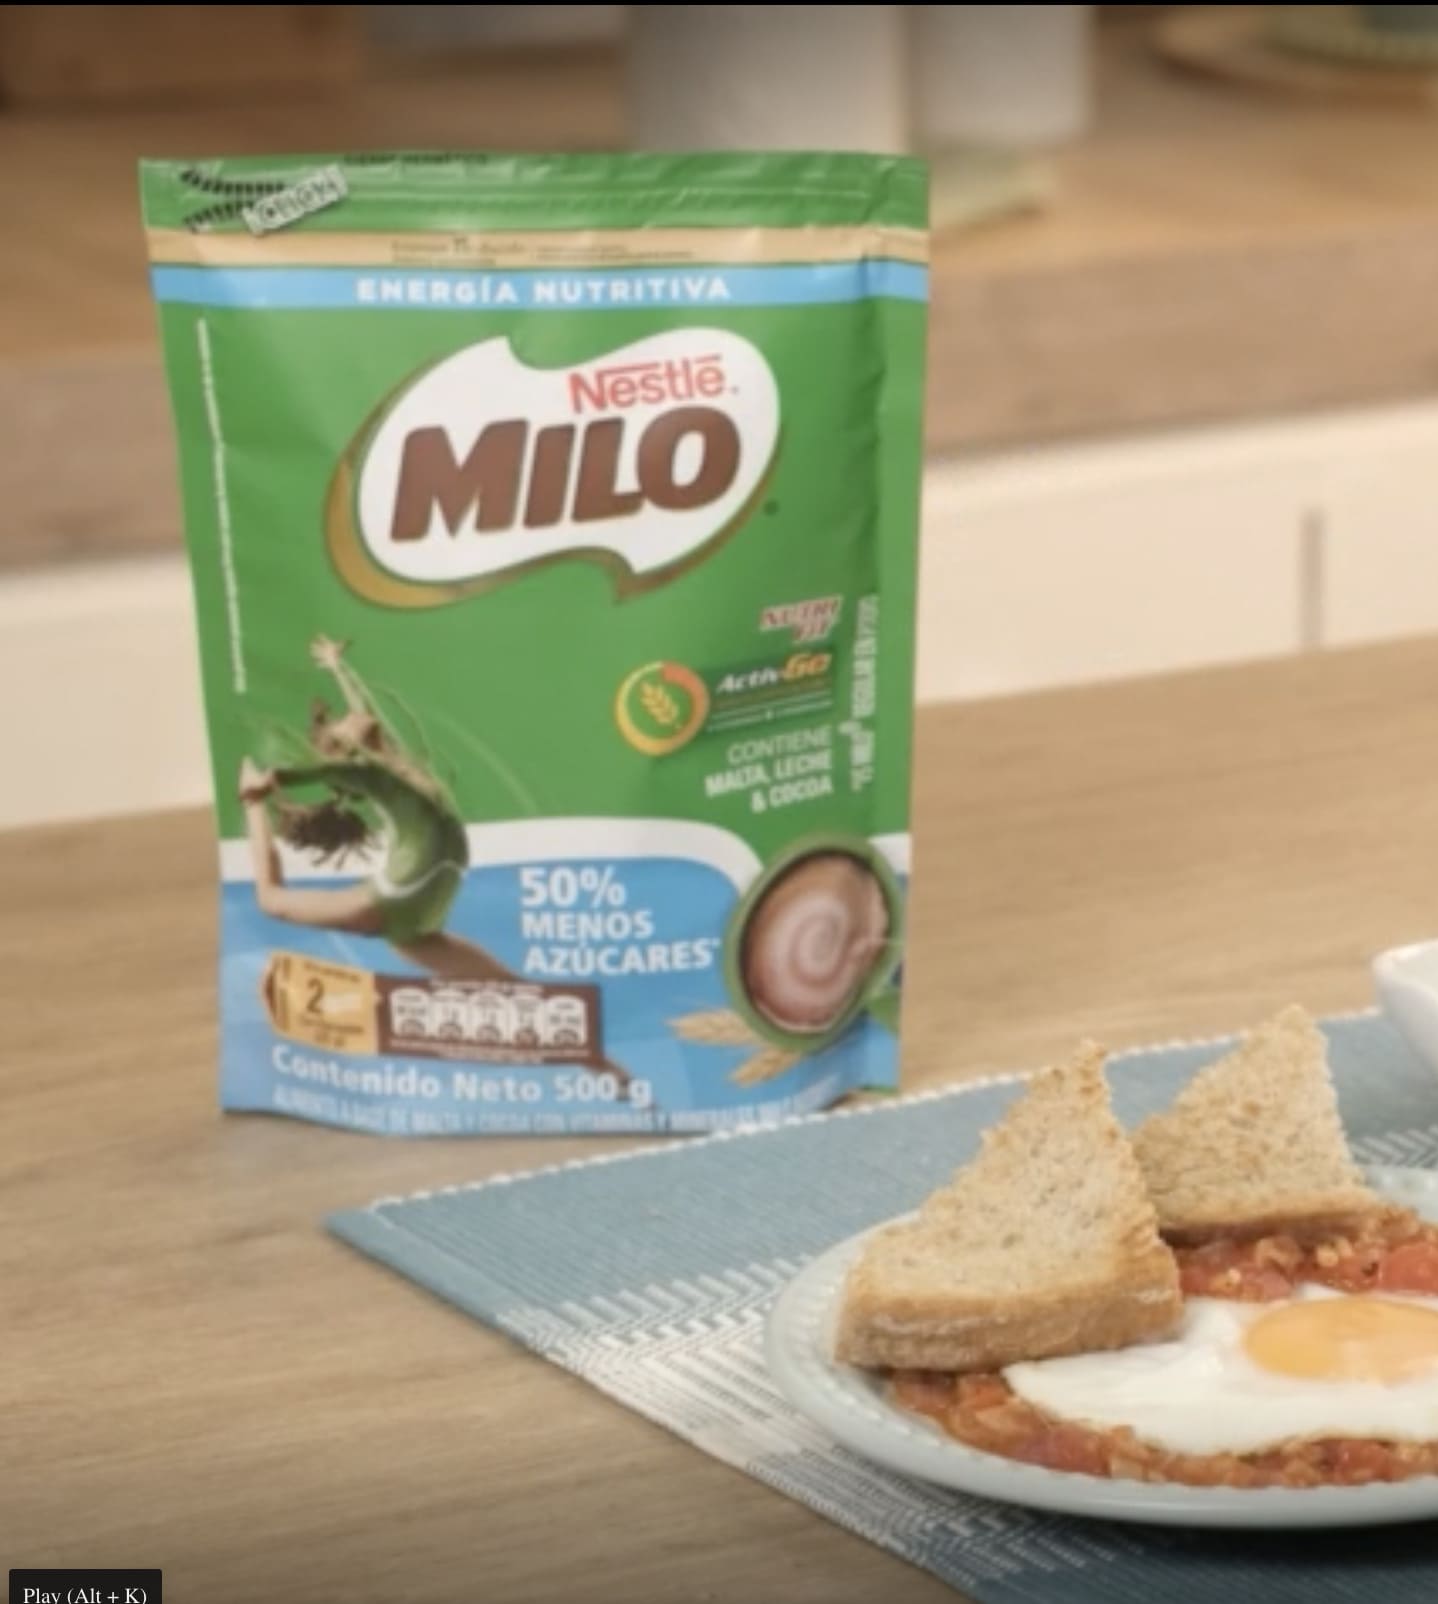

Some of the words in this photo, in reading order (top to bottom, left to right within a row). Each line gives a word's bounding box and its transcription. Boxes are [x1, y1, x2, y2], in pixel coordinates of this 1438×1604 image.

[356, 275, 518, 303] ENERGÍA
[533, 276, 730, 303] NUTRITIVA
[390, 406, 742, 543] MILO
[727, 724, 832, 766] CONTIENE
[773, 750, 832, 780] LECHE
[768, 775, 834, 808] COCOA
[519, 864, 628, 909] 50%
[521, 909, 655, 942] MENOS
[305, 976, 326, 1016] 2
[271, 1043, 441, 1100] Contenido
[453, 1071, 543, 1103] Neto
[551, 1071, 618, 1102] 500
[627, 1076, 653, 1110] g
